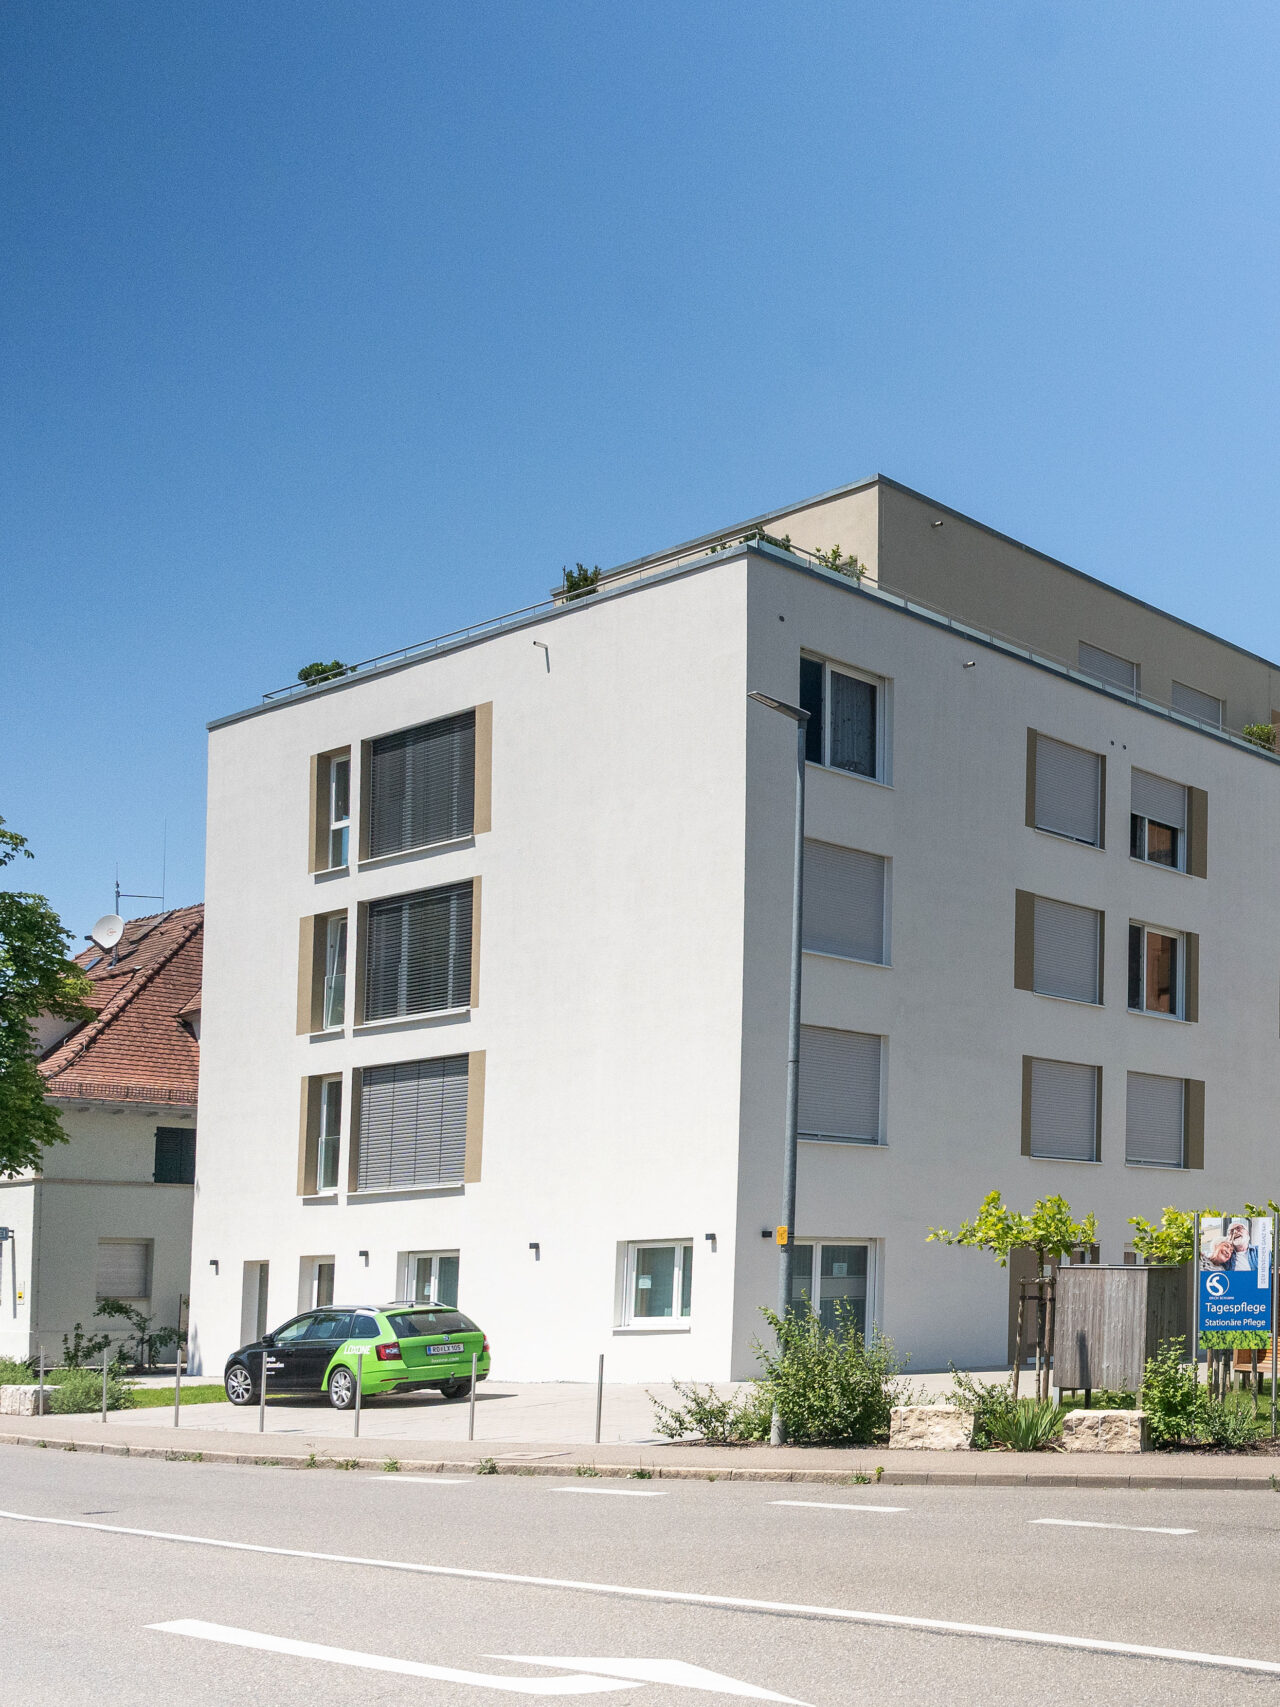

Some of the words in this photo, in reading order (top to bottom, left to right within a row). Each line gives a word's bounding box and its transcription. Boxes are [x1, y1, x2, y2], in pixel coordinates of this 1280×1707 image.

[1205, 1301, 1266, 1315] Tagespflege
[1204, 1318, 1242, 1327] Stationäre
[1243, 1318, 1266, 1328] Pflege
[343, 1344, 371, 1355] LOXONE
